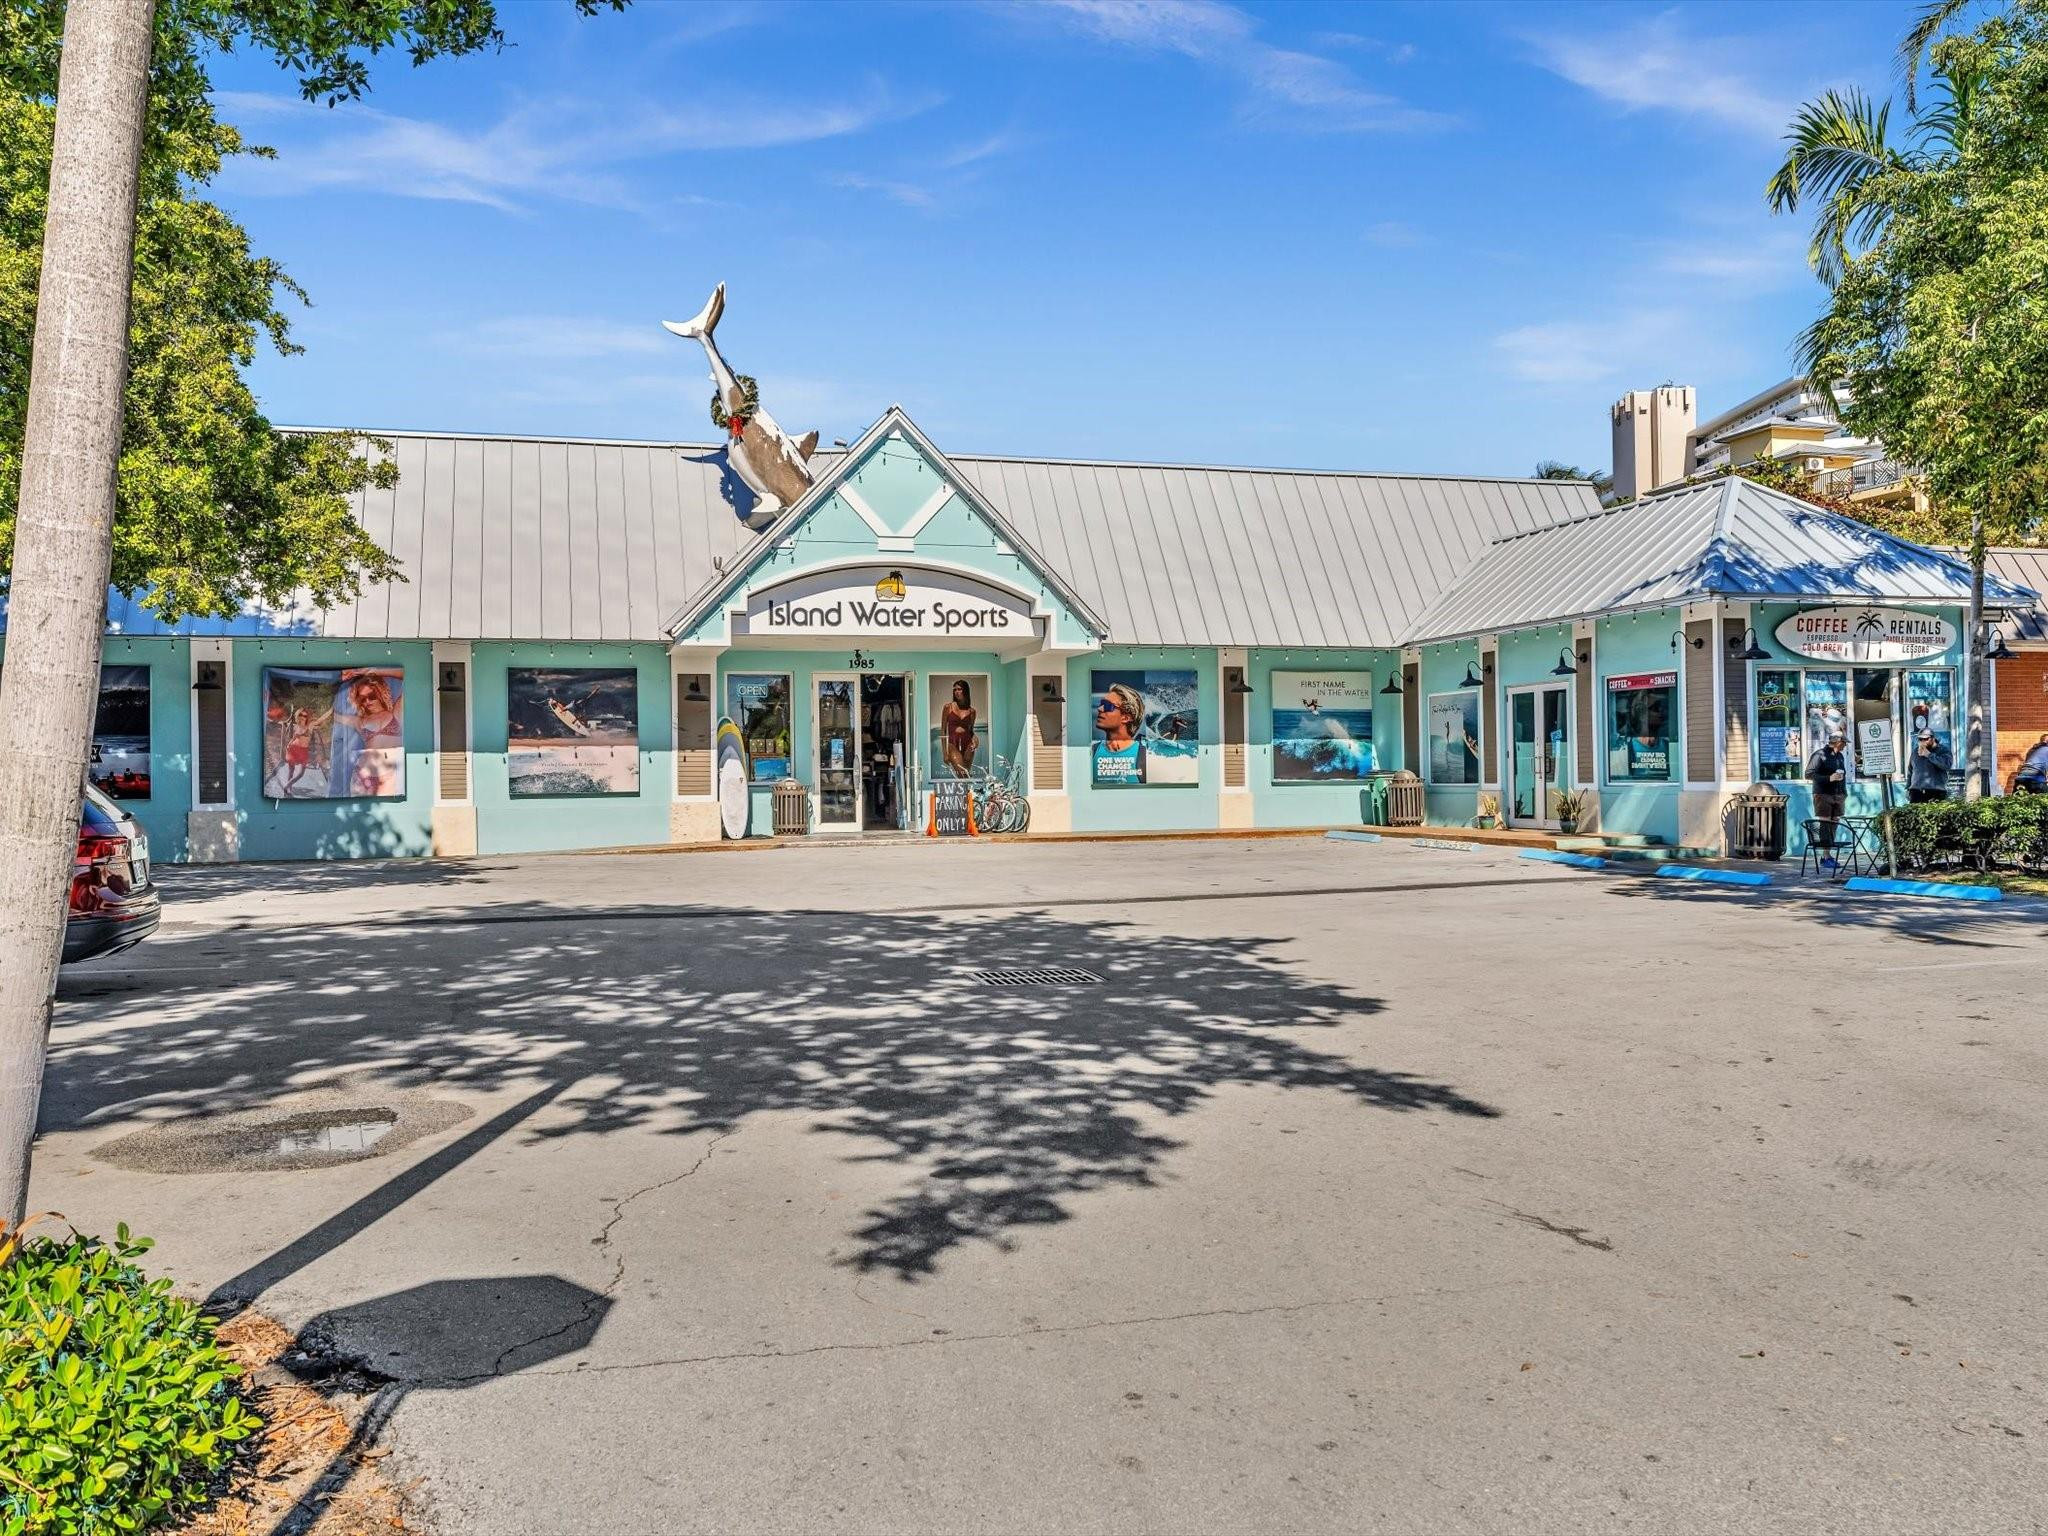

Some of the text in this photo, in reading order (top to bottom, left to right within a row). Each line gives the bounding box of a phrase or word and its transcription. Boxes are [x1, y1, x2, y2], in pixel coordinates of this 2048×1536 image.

[768, 600, 1009, 633] Island Water Sports
[1796, 618, 1848, 633] COFFEE
[1890, 620, 1941, 636] RENTALS
[1806, 634, 1839, 642] ESPRESSO
[1802, 643, 1843, 652] COLD BREW
[1902, 645, 1930, 654] LESSONS
[849, 658, 875, 669] 1985
[1609, 679, 1628, 689] COFFEE
[1654, 675, 1676, 686] SNACKS
[739, 685, 766, 696] OPEN
[1344, 689, 1369, 697] WATER
[935, 795, 967, 811] PARKING
[936, 817, 966, 831] ONLY!
